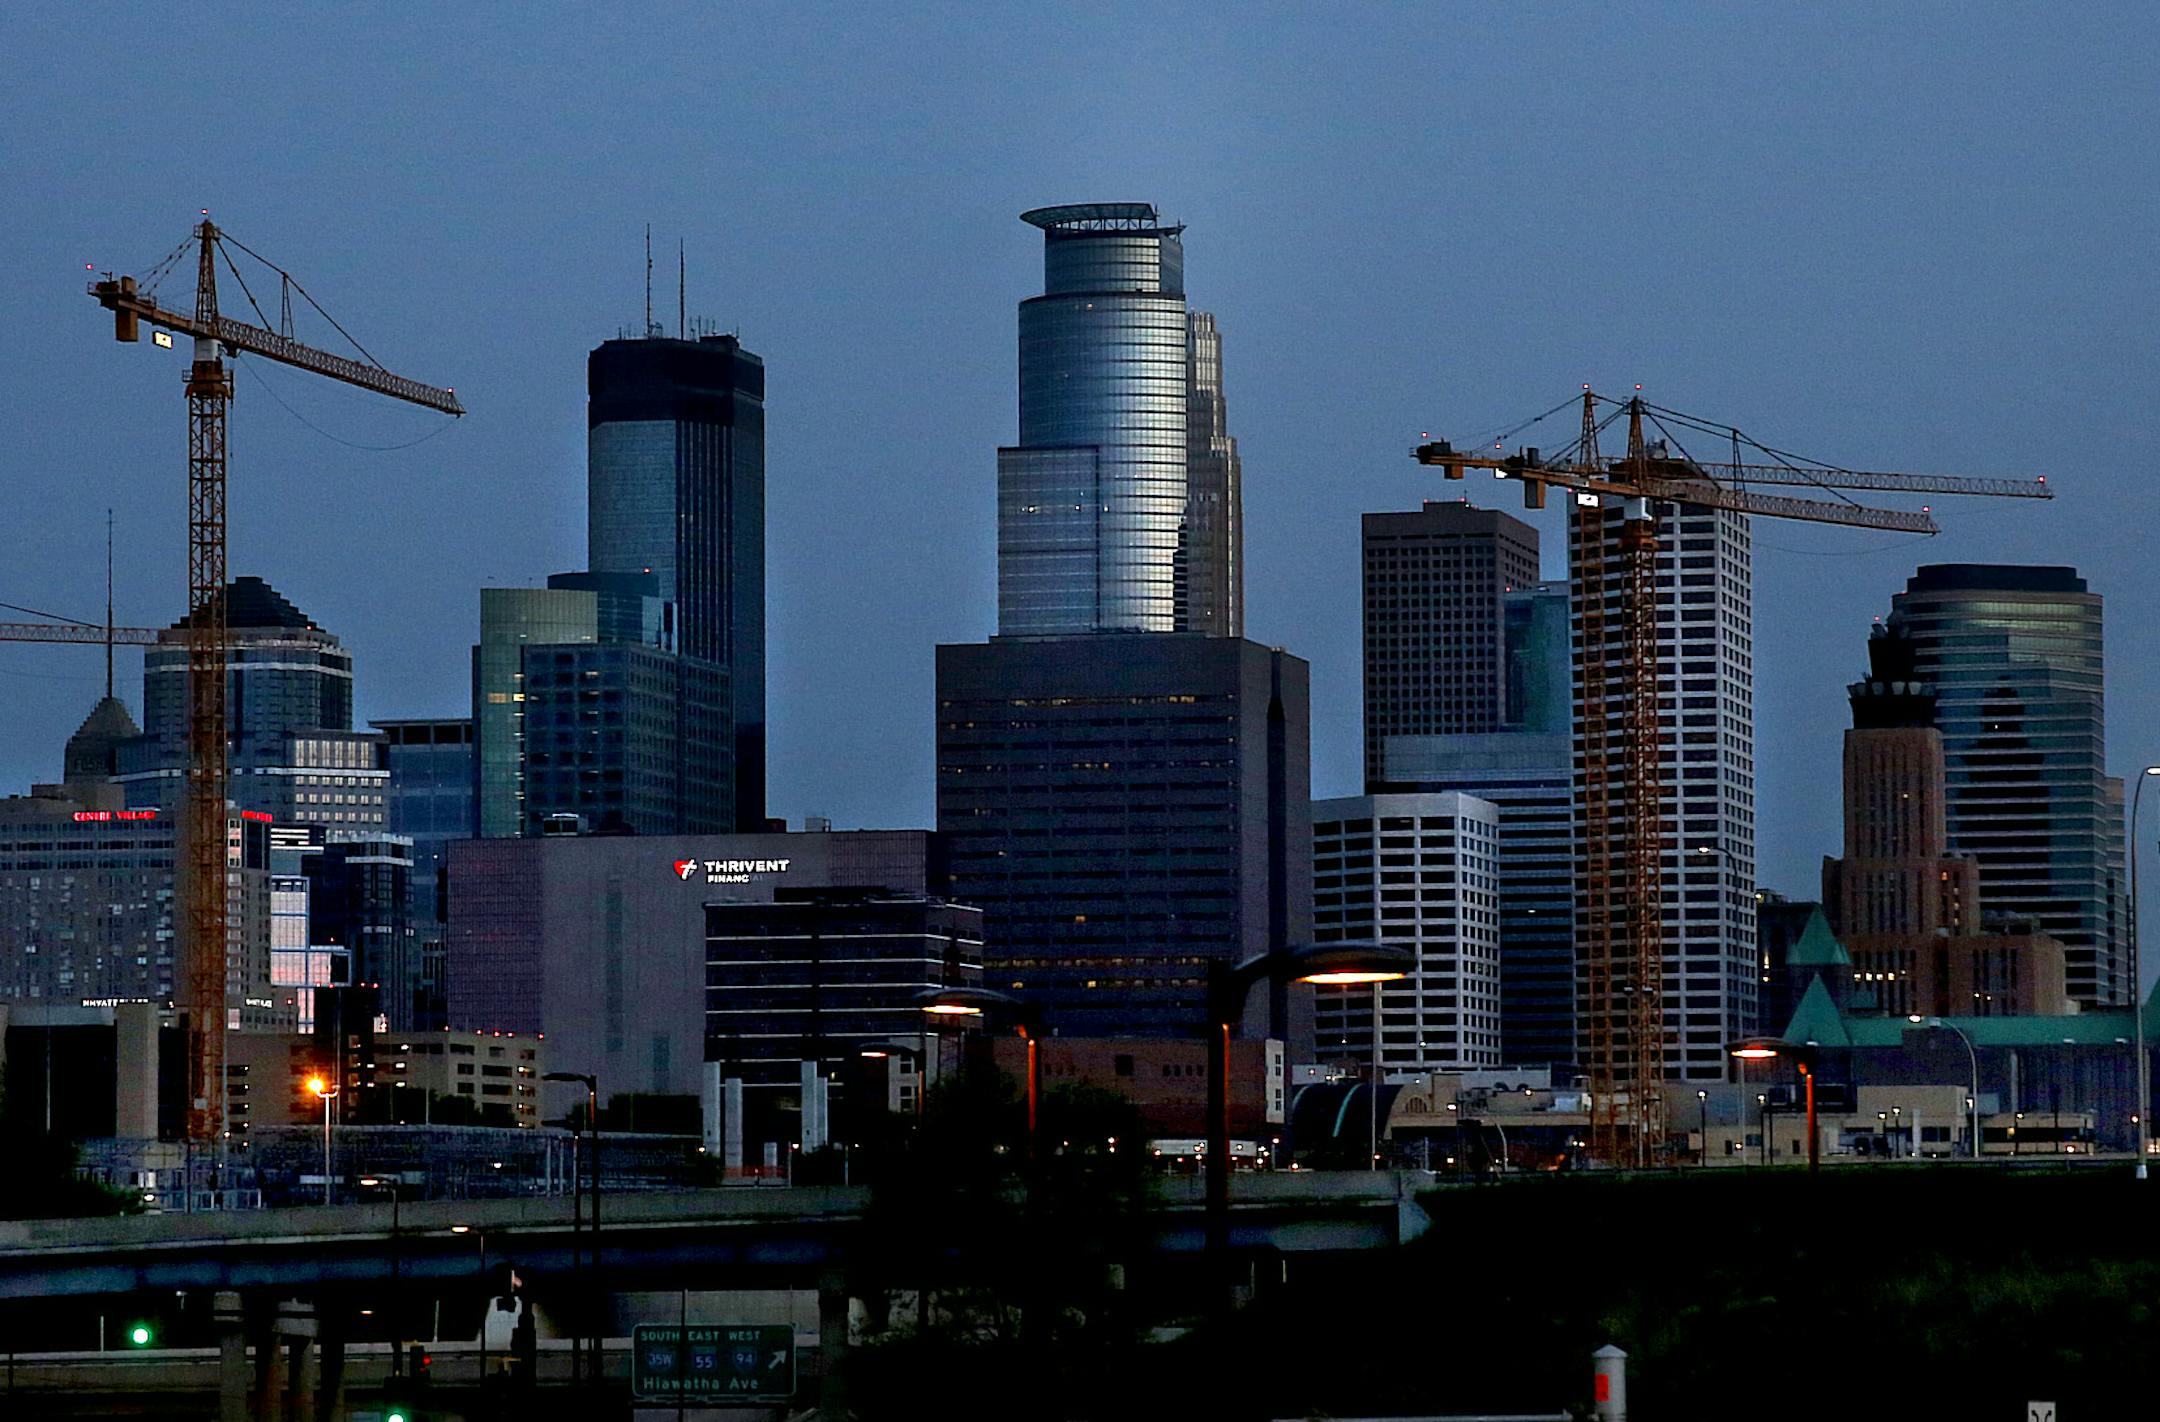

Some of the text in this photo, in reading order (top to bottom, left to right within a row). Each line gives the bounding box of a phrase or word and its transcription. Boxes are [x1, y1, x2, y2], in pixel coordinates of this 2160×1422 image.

[703, 859, 790, 873] THRIVENT
[640, 1331, 761, 1342] SOUTH EAST WEST
[648, 1353, 753, 1369] 35W 55 94
[643, 1377, 759, 1390] Hiawatha Ave
